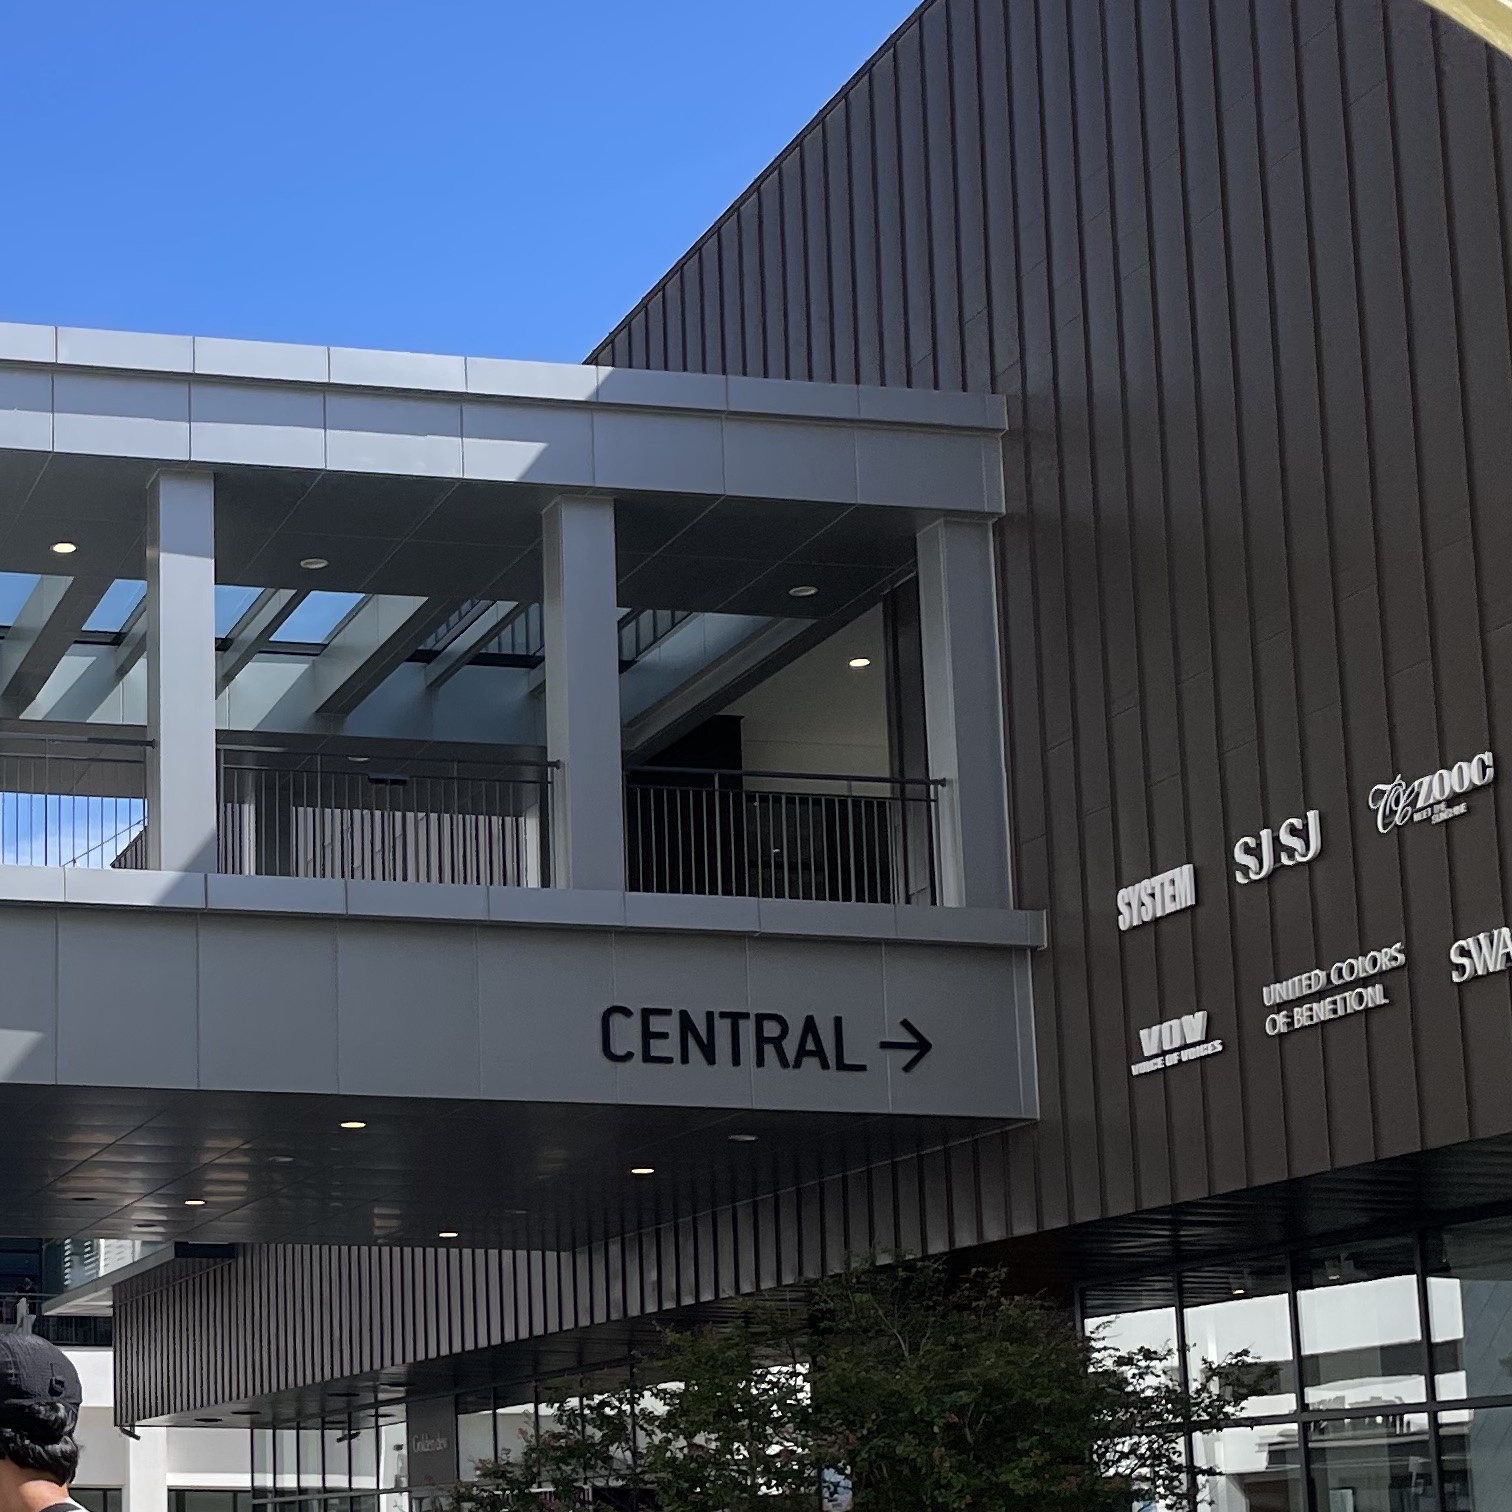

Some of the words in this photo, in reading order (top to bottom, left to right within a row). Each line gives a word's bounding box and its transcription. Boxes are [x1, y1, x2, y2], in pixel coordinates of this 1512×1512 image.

[1117, 864, 1196, 931] SYSTEM
[1263, 968, 1326, 1006] UNITED
[1330, 942, 1406, 985] COLORS
[601, 1005, 867, 1072] CENTRAL
[1139, 1010, 1208, 1058] VOV
[1265, 1011, 1291, 1036] OF
